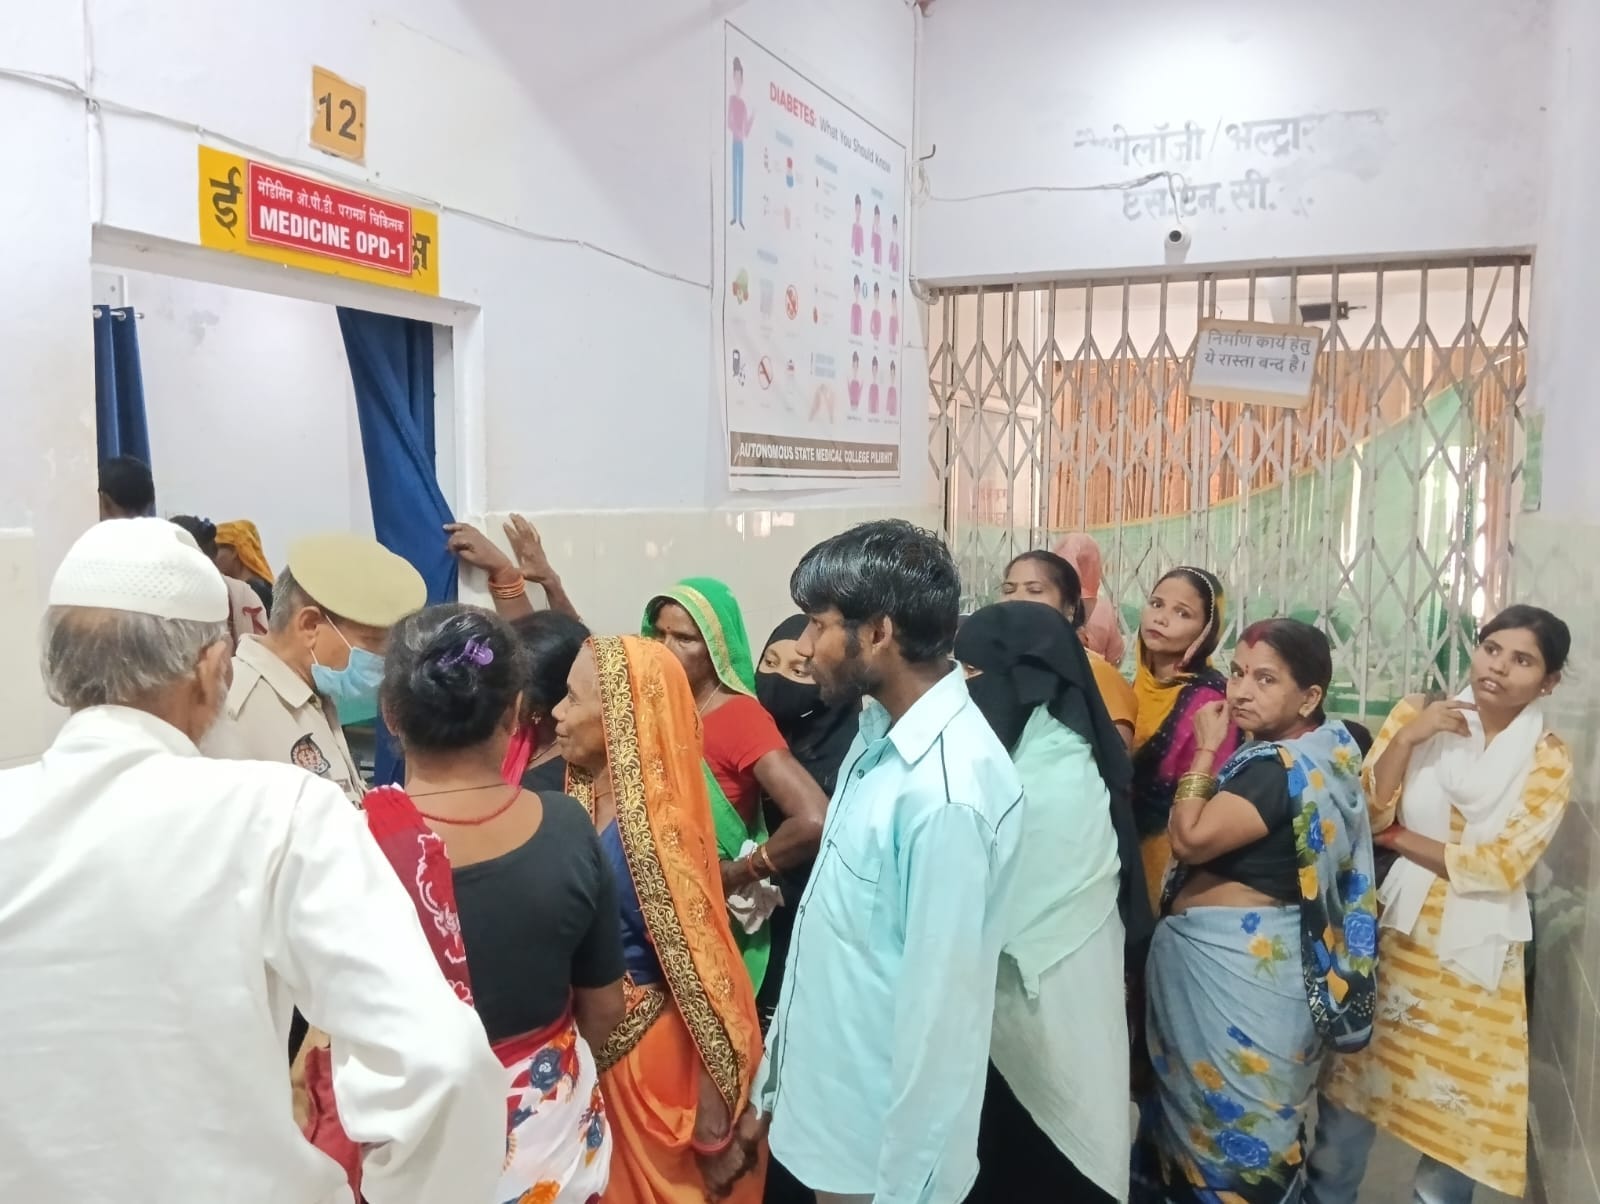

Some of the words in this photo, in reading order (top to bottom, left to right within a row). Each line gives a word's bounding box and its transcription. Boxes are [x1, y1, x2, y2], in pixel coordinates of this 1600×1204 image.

[318, 92, 358, 141] 12
[769, 81, 817, 129] DIABETES:
[820, 116, 839, 141] What
[840, 128, 852, 150] You
[853, 138, 875, 164] Should
[257, 176, 294, 204] मेडिसिन
[259, 205, 351, 251] MEDICINE
[356, 230, 404, 263] OPD-1
[1207, 328, 1251, 348] निर्माण
[1256, 332, 1287, 350] कार्य
[1289, 334, 1311, 356] हेतु
[1204, 348, 1216, 366] ये
[1219, 353, 1255, 369] रास्ता
[1258, 355, 1285, 373] बन्द
[739, 441, 794, 460] AUTONOMOUS
[794, 446, 815, 461] STATE
[815, 448, 843, 463] MEDICAL
[844, 450, 870, 464] COLLEGE
[870, 451, 894, 465] PILIBHIT
